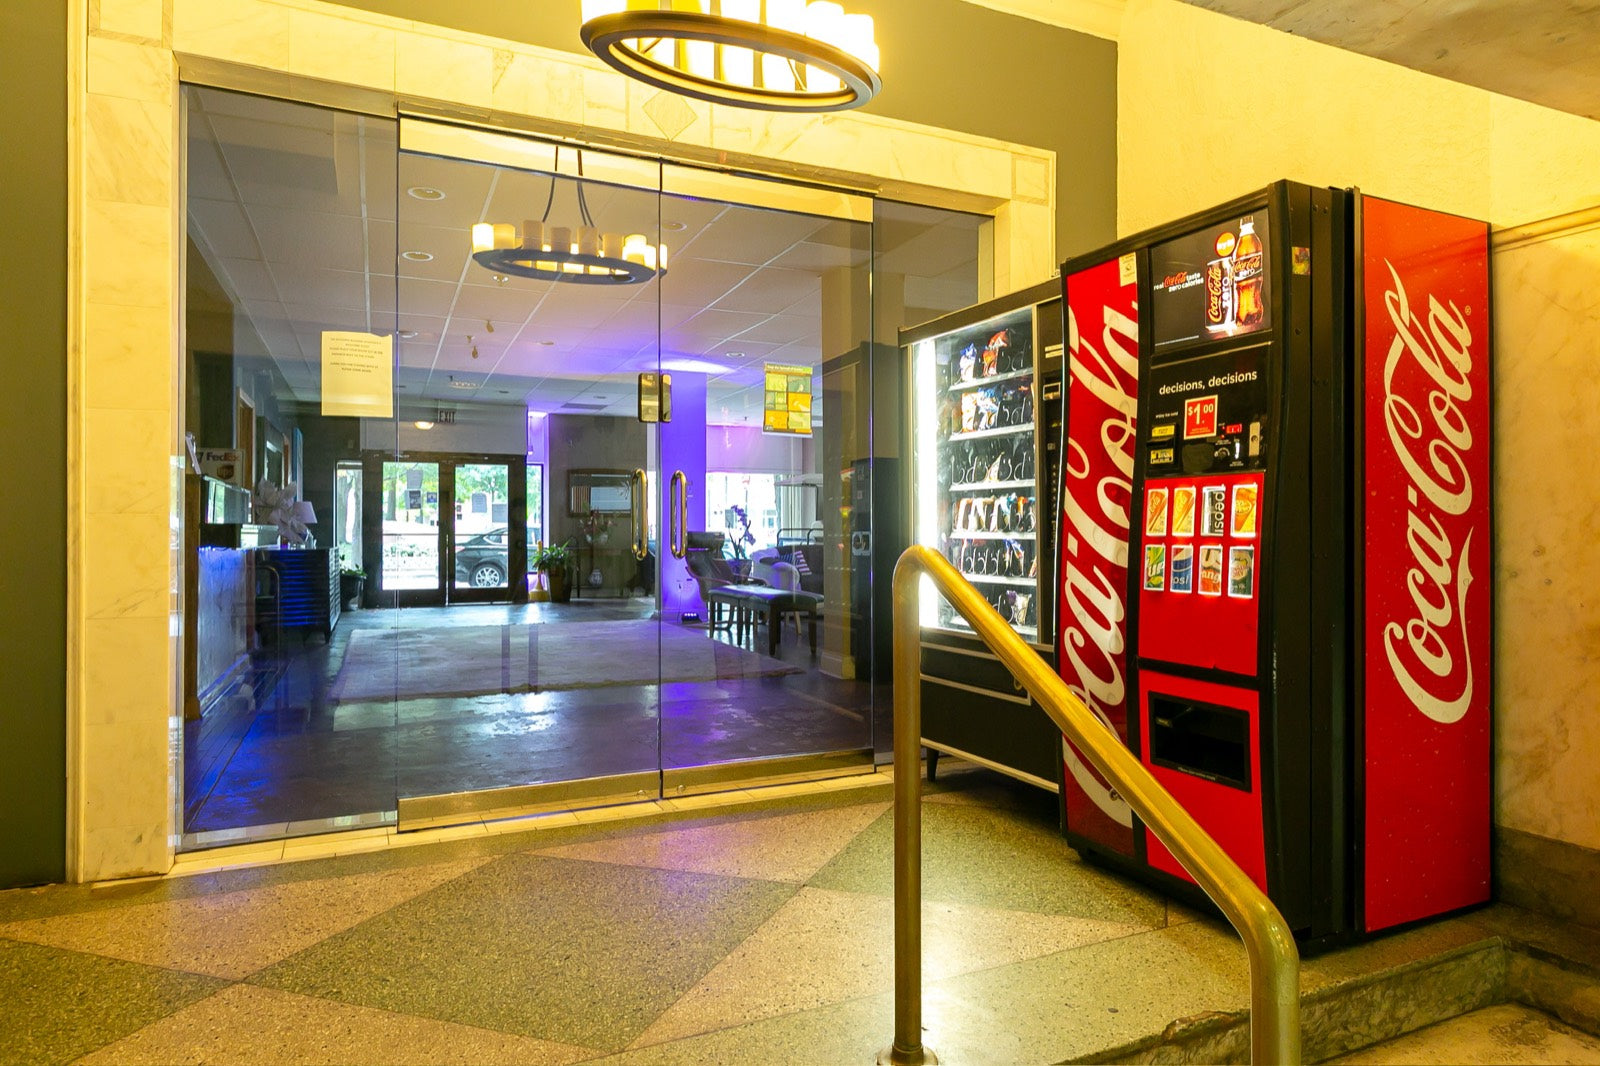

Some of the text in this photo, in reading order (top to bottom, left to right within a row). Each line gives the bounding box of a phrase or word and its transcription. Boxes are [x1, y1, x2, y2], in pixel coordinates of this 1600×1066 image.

[1208, 267, 1222, 323] Coca-Cola
[1159, 371, 1258, 395] decisions, decisions
[439, 410, 456, 423] EXIT
[207, 451, 240, 462] FedEx
[1384, 258, 1473, 724] Coca-Cola
[1213, 491, 1226, 533] pepsi
